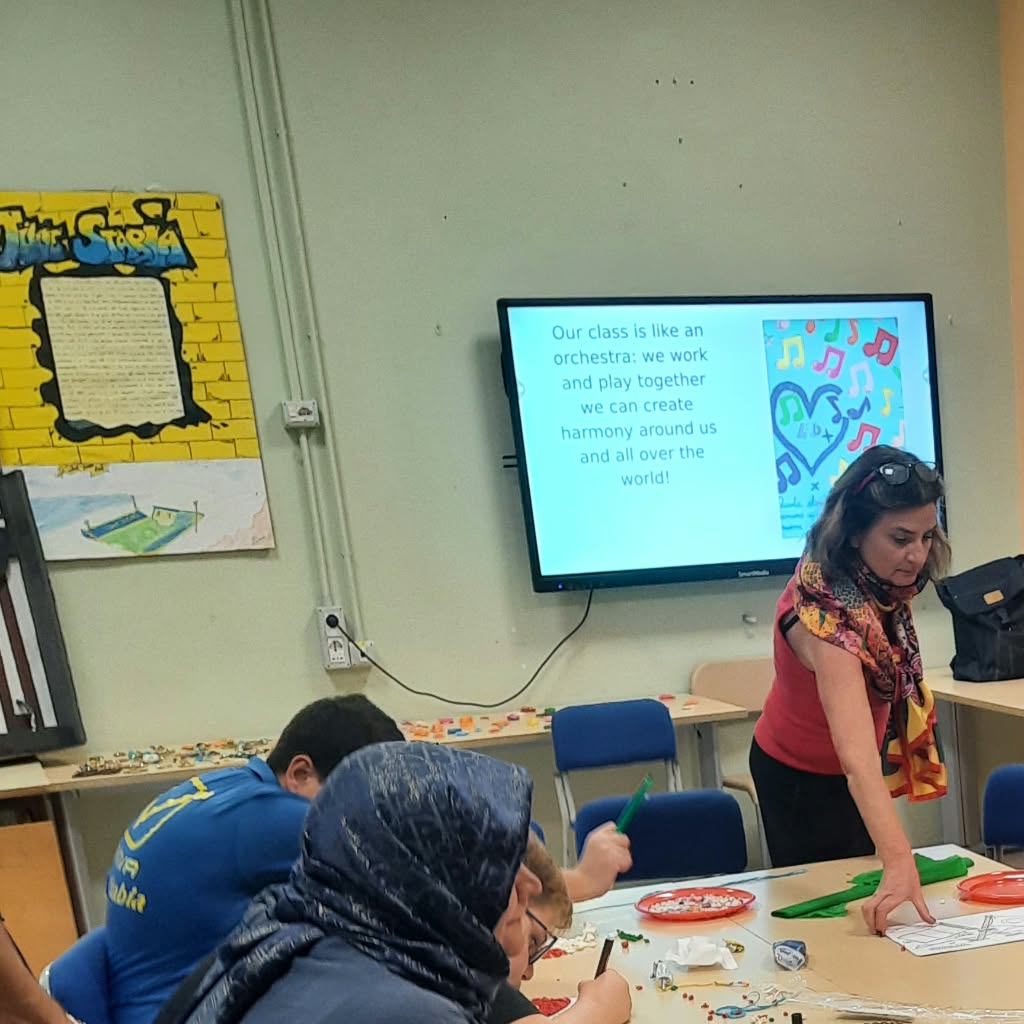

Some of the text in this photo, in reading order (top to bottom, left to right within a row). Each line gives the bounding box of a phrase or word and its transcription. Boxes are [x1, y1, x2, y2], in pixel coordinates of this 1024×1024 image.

[552, 322, 704, 340] Our class is like an
[553, 347, 708, 365] orchestra: we work
[562, 372, 706, 392] and play together
[580, 397, 694, 414] we can create
[561, 420, 717, 441] harmony around us
[580, 444, 705, 464] and all over the
[621, 470, 670, 486] world!
